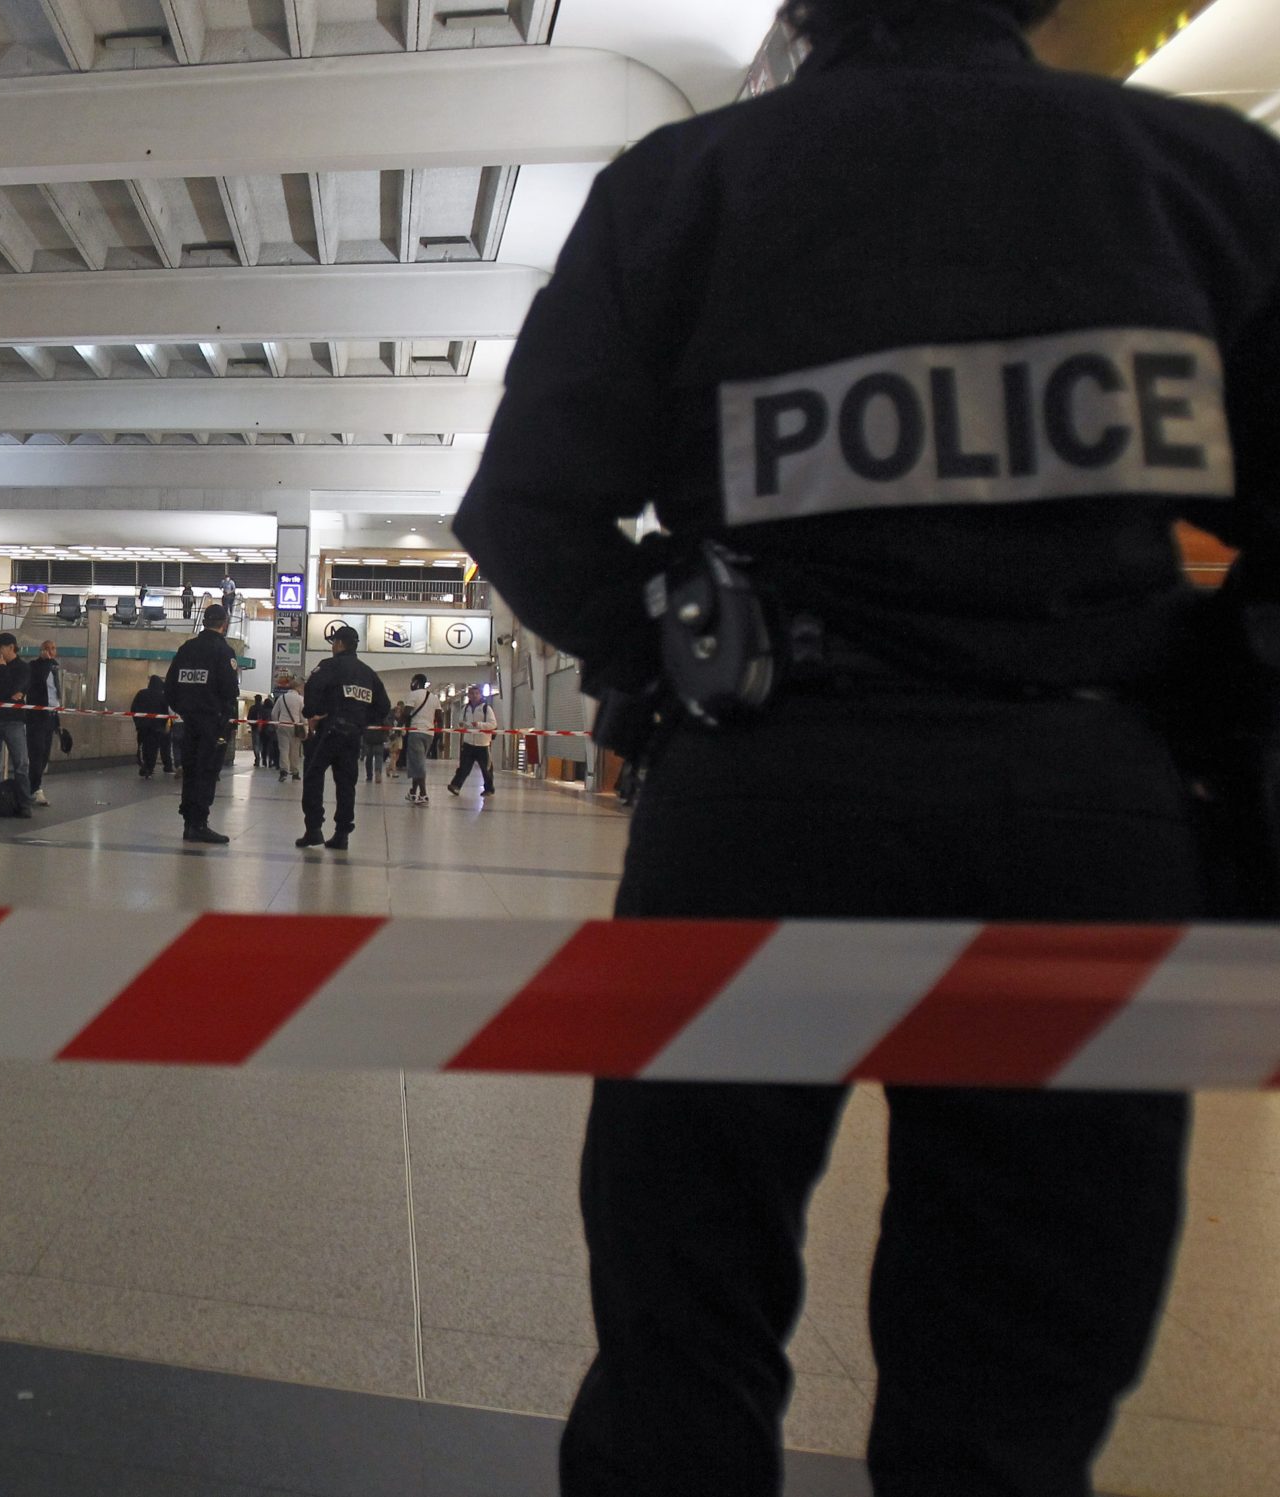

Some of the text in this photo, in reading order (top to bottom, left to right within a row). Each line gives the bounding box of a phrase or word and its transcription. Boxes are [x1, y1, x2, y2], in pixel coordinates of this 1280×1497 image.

[752, 351, 1208, 497] POLICE
[284, 587, 297, 602] A
[453, 629, 466, 644] T
[180, 670, 206, 681] POICE
